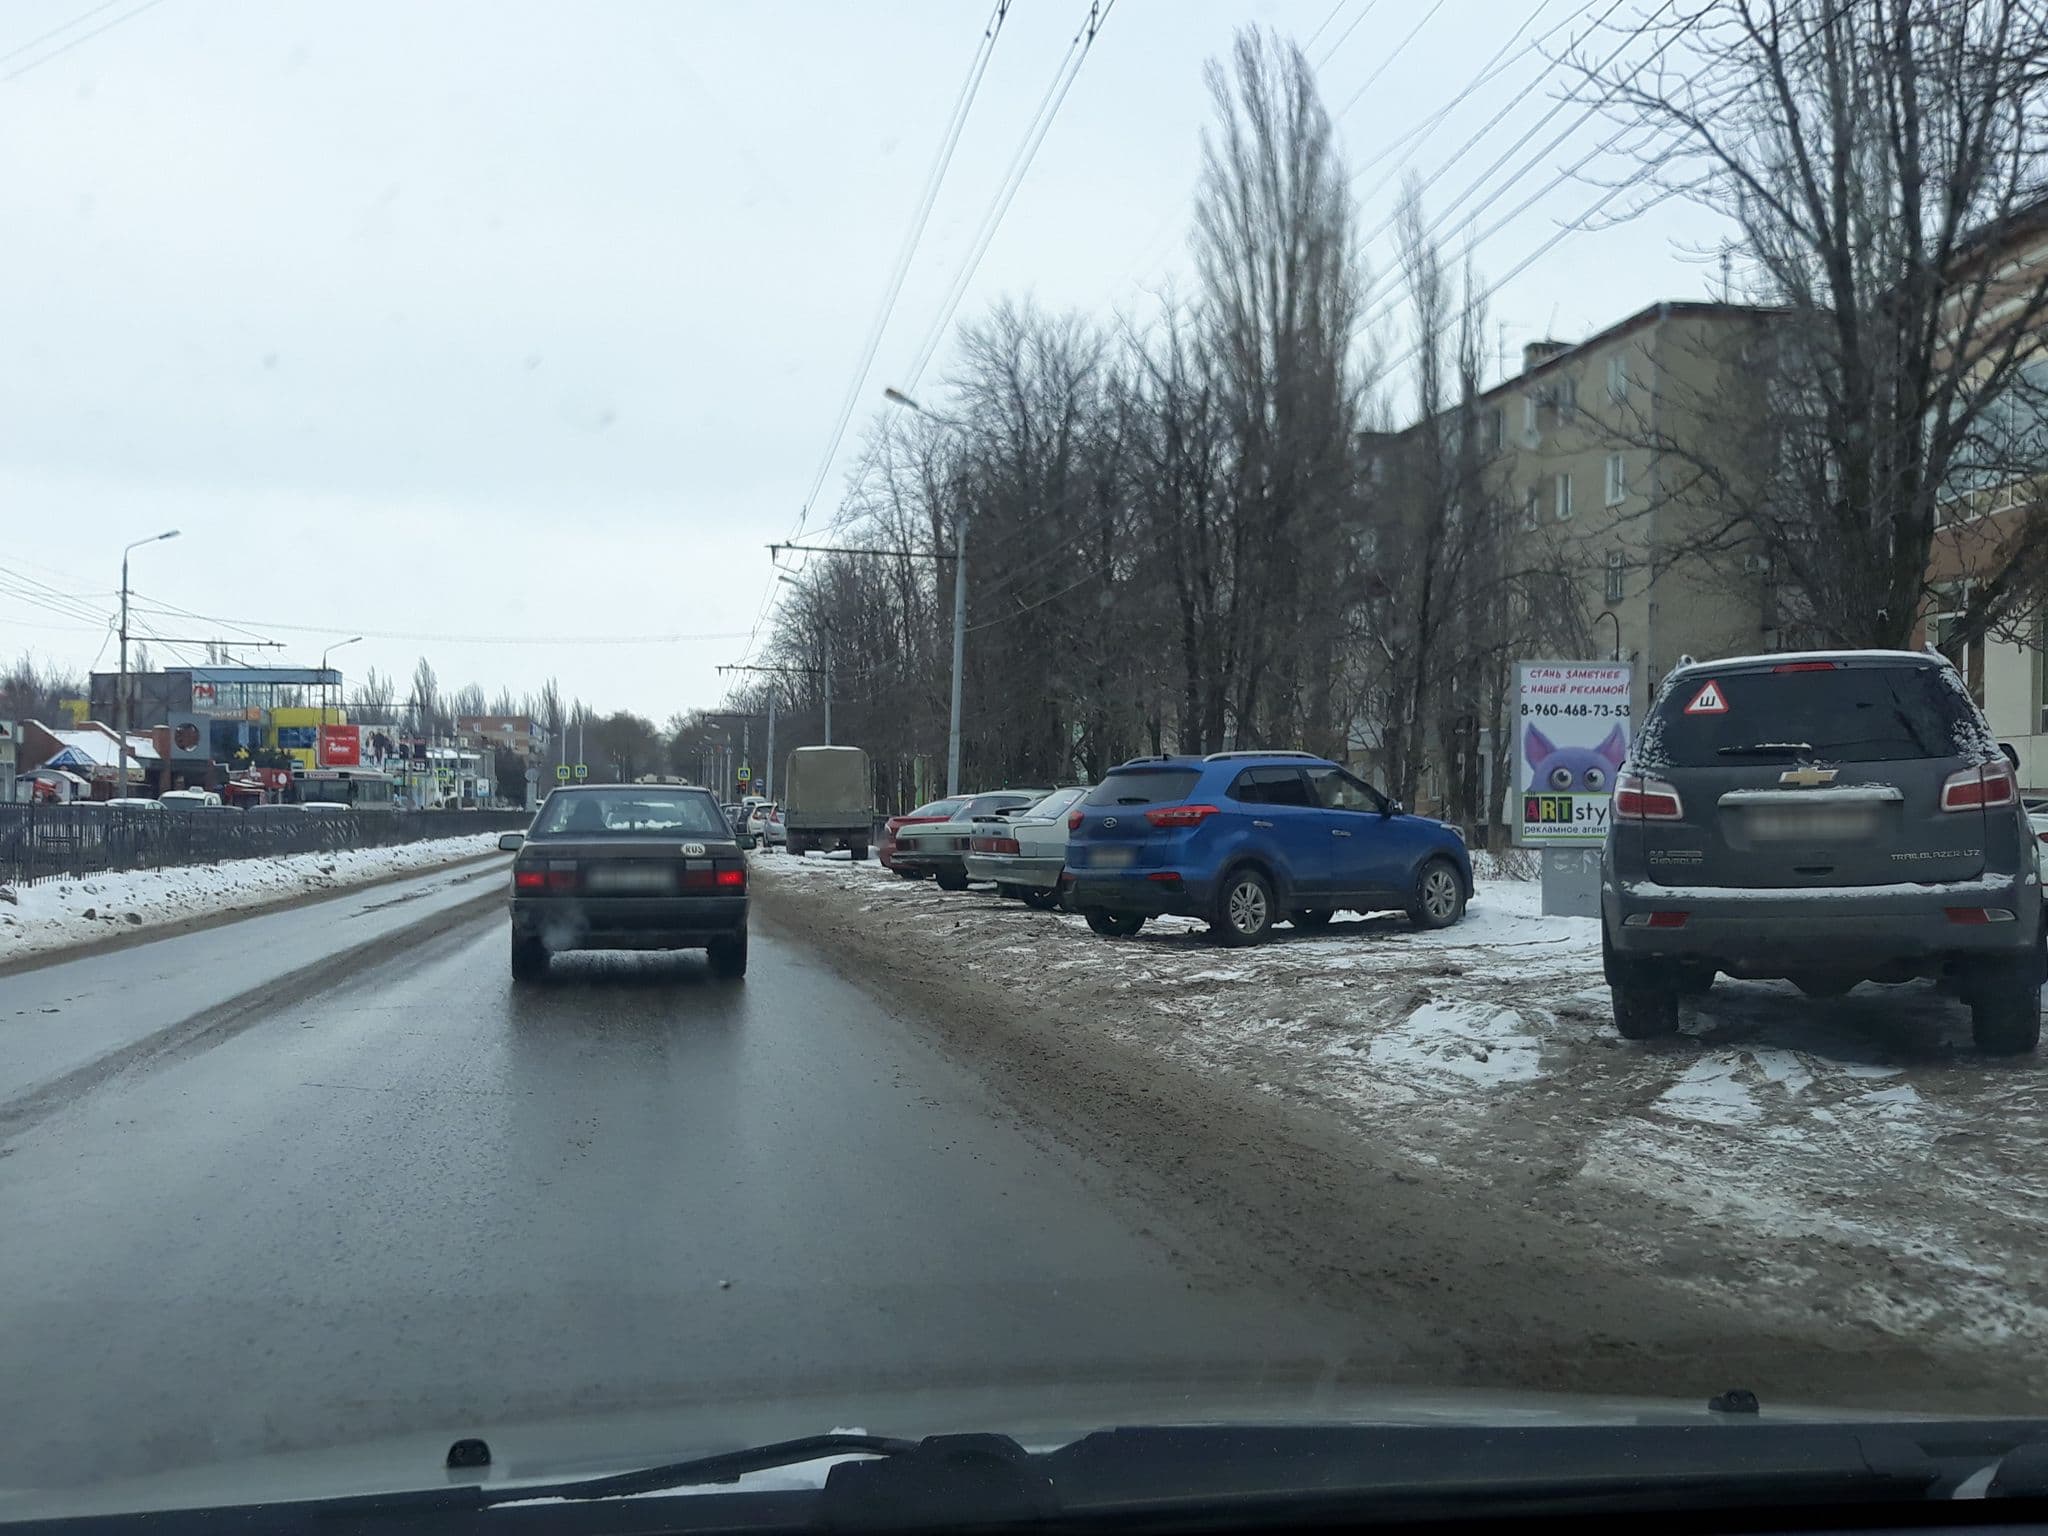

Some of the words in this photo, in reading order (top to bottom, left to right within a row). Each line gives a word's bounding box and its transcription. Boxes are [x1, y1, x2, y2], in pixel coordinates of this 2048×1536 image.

[1530, 669, 1561, 679] СТАНЬ
[1566, 669, 1620, 679] ЗАМЕТНЕЕ
[1521, 686, 1527, 694] С
[1531, 683, 1566, 694] НАШЕЙ
[1570, 682, 1630, 695] РЕКЛАМОЙ!
[1700, 695, 1716, 707] Ш
[1521, 703, 1630, 717] 8-960-468-73-53
[1524, 826, 1578, 834] рекламное
[686, 845, 704, 854] RUS
[1890, 851, 1960, 860] TRAILBLAZER
[1963, 849, 1981, 857] LTZ
